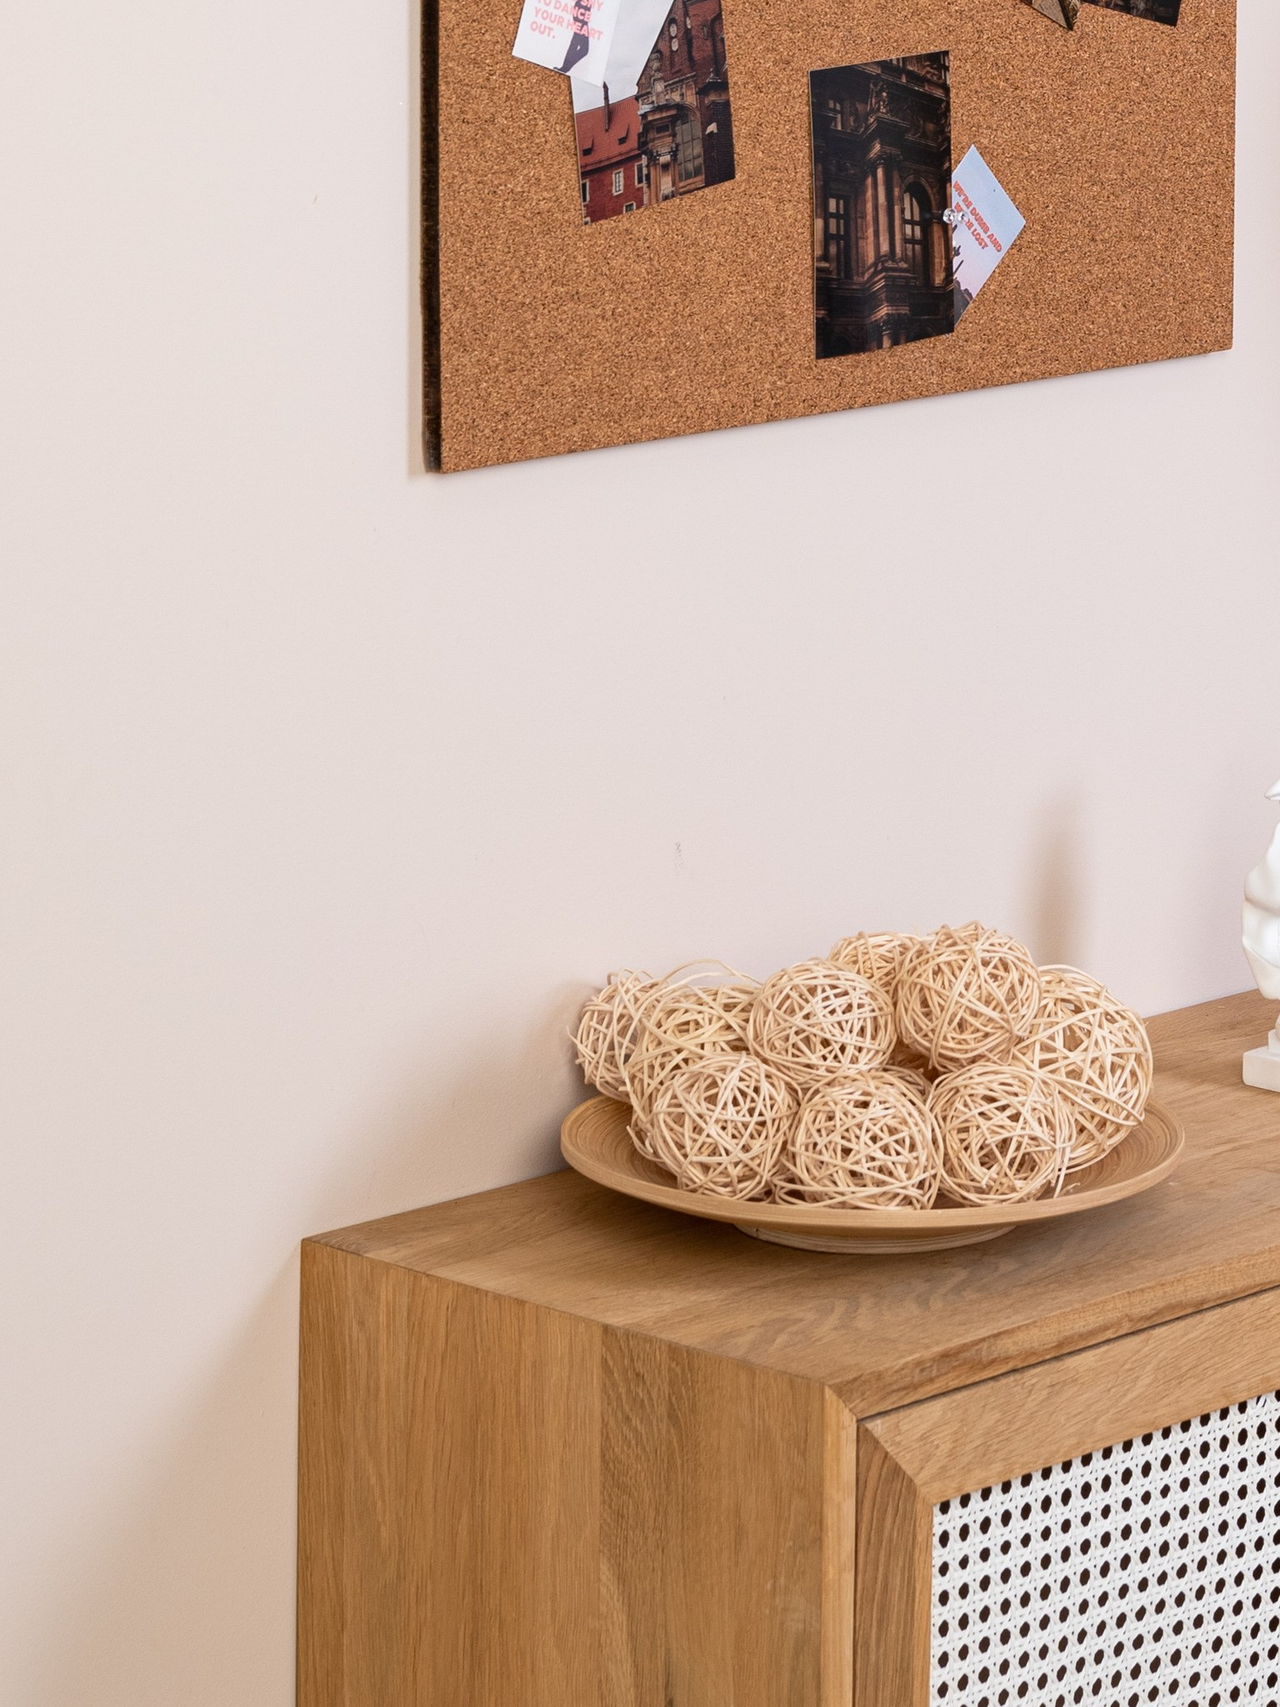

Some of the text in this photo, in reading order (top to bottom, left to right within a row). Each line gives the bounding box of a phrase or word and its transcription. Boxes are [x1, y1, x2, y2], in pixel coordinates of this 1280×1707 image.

[554, 0, 591, 22] DANCE
[530, 21, 555, 39] OUT.
[534, 6, 603, 41] YOUR HEART
[970, 206, 990, 234] DUMB
[987, 233, 1003, 252] AND
[971, 228, 988, 249] LOST
